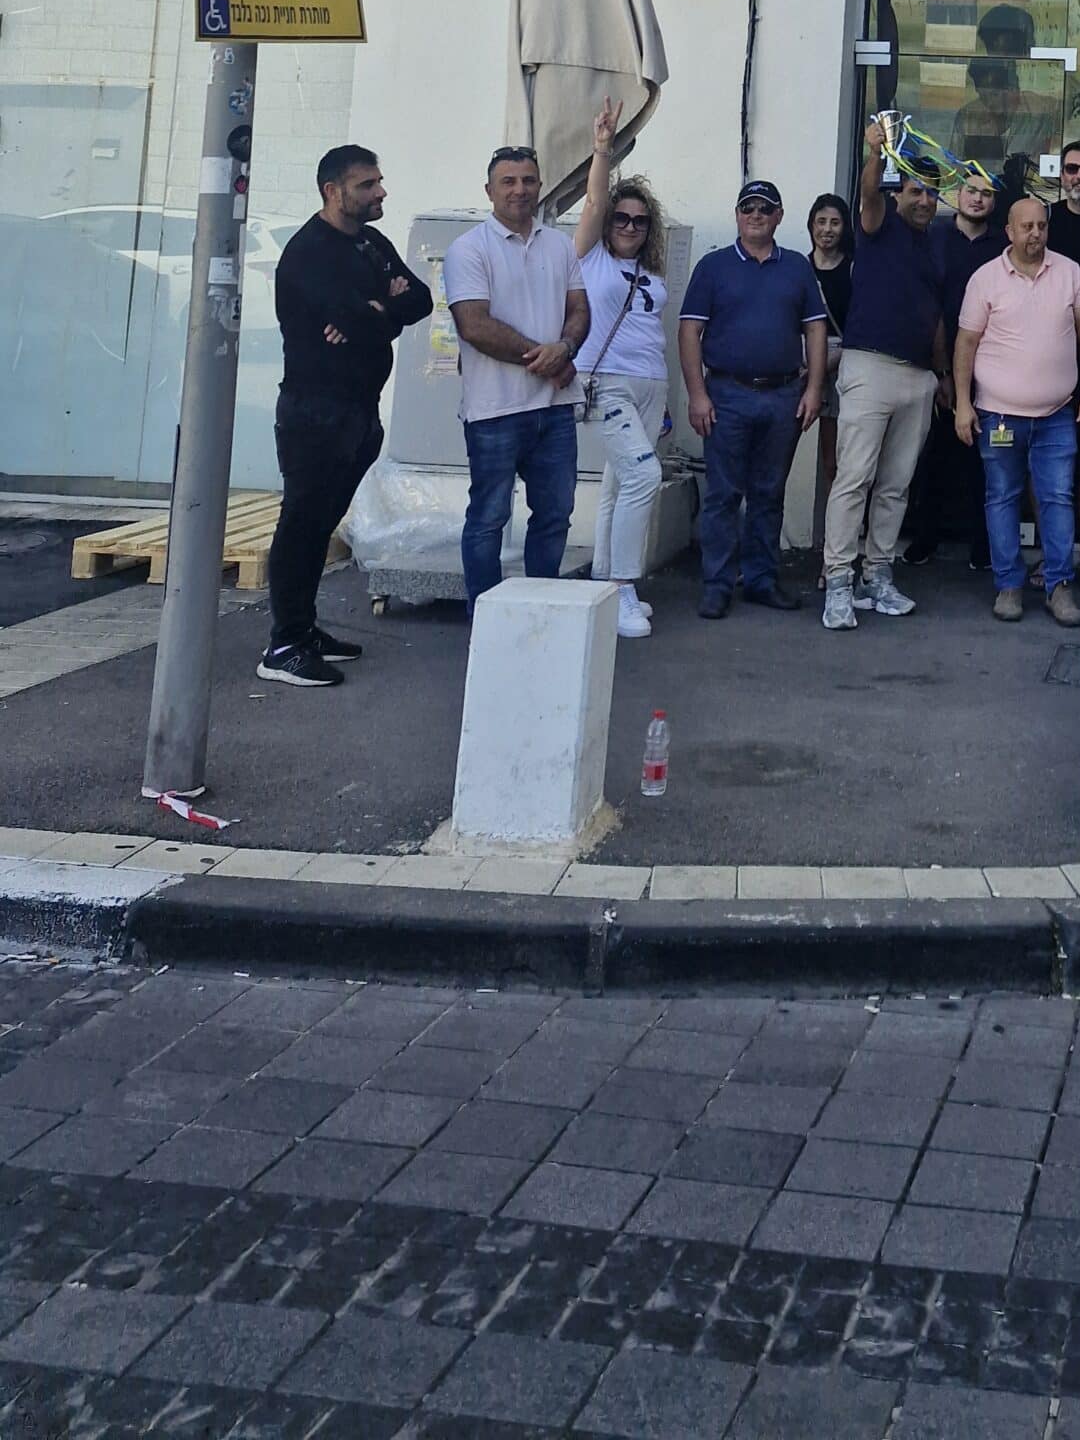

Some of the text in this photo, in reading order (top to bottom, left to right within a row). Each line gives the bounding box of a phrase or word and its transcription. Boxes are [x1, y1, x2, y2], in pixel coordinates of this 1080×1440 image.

[230, 0, 331, 25] מותרת חניית נכה בלבד
